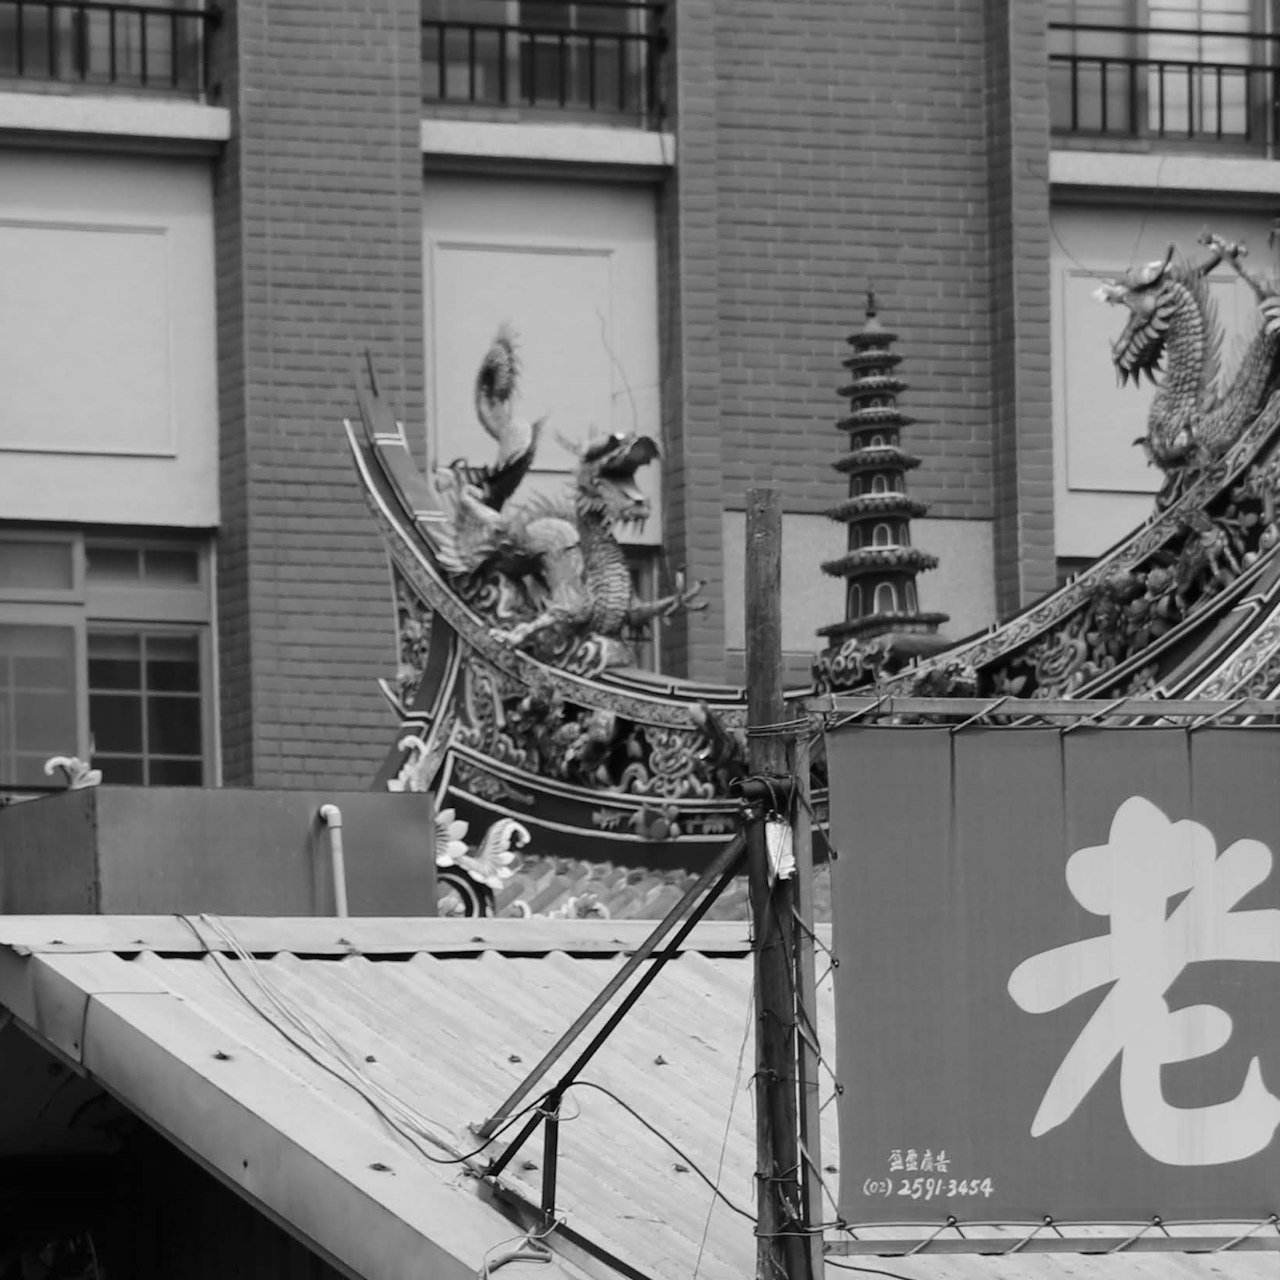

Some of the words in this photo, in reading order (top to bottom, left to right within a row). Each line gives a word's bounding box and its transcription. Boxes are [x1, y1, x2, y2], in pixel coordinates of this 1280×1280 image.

[1007, 796, 1280, 1166] 老
[863, 1177, 893, 1197] (02)
[897, 1177, 995, 1201] 2591-3454
